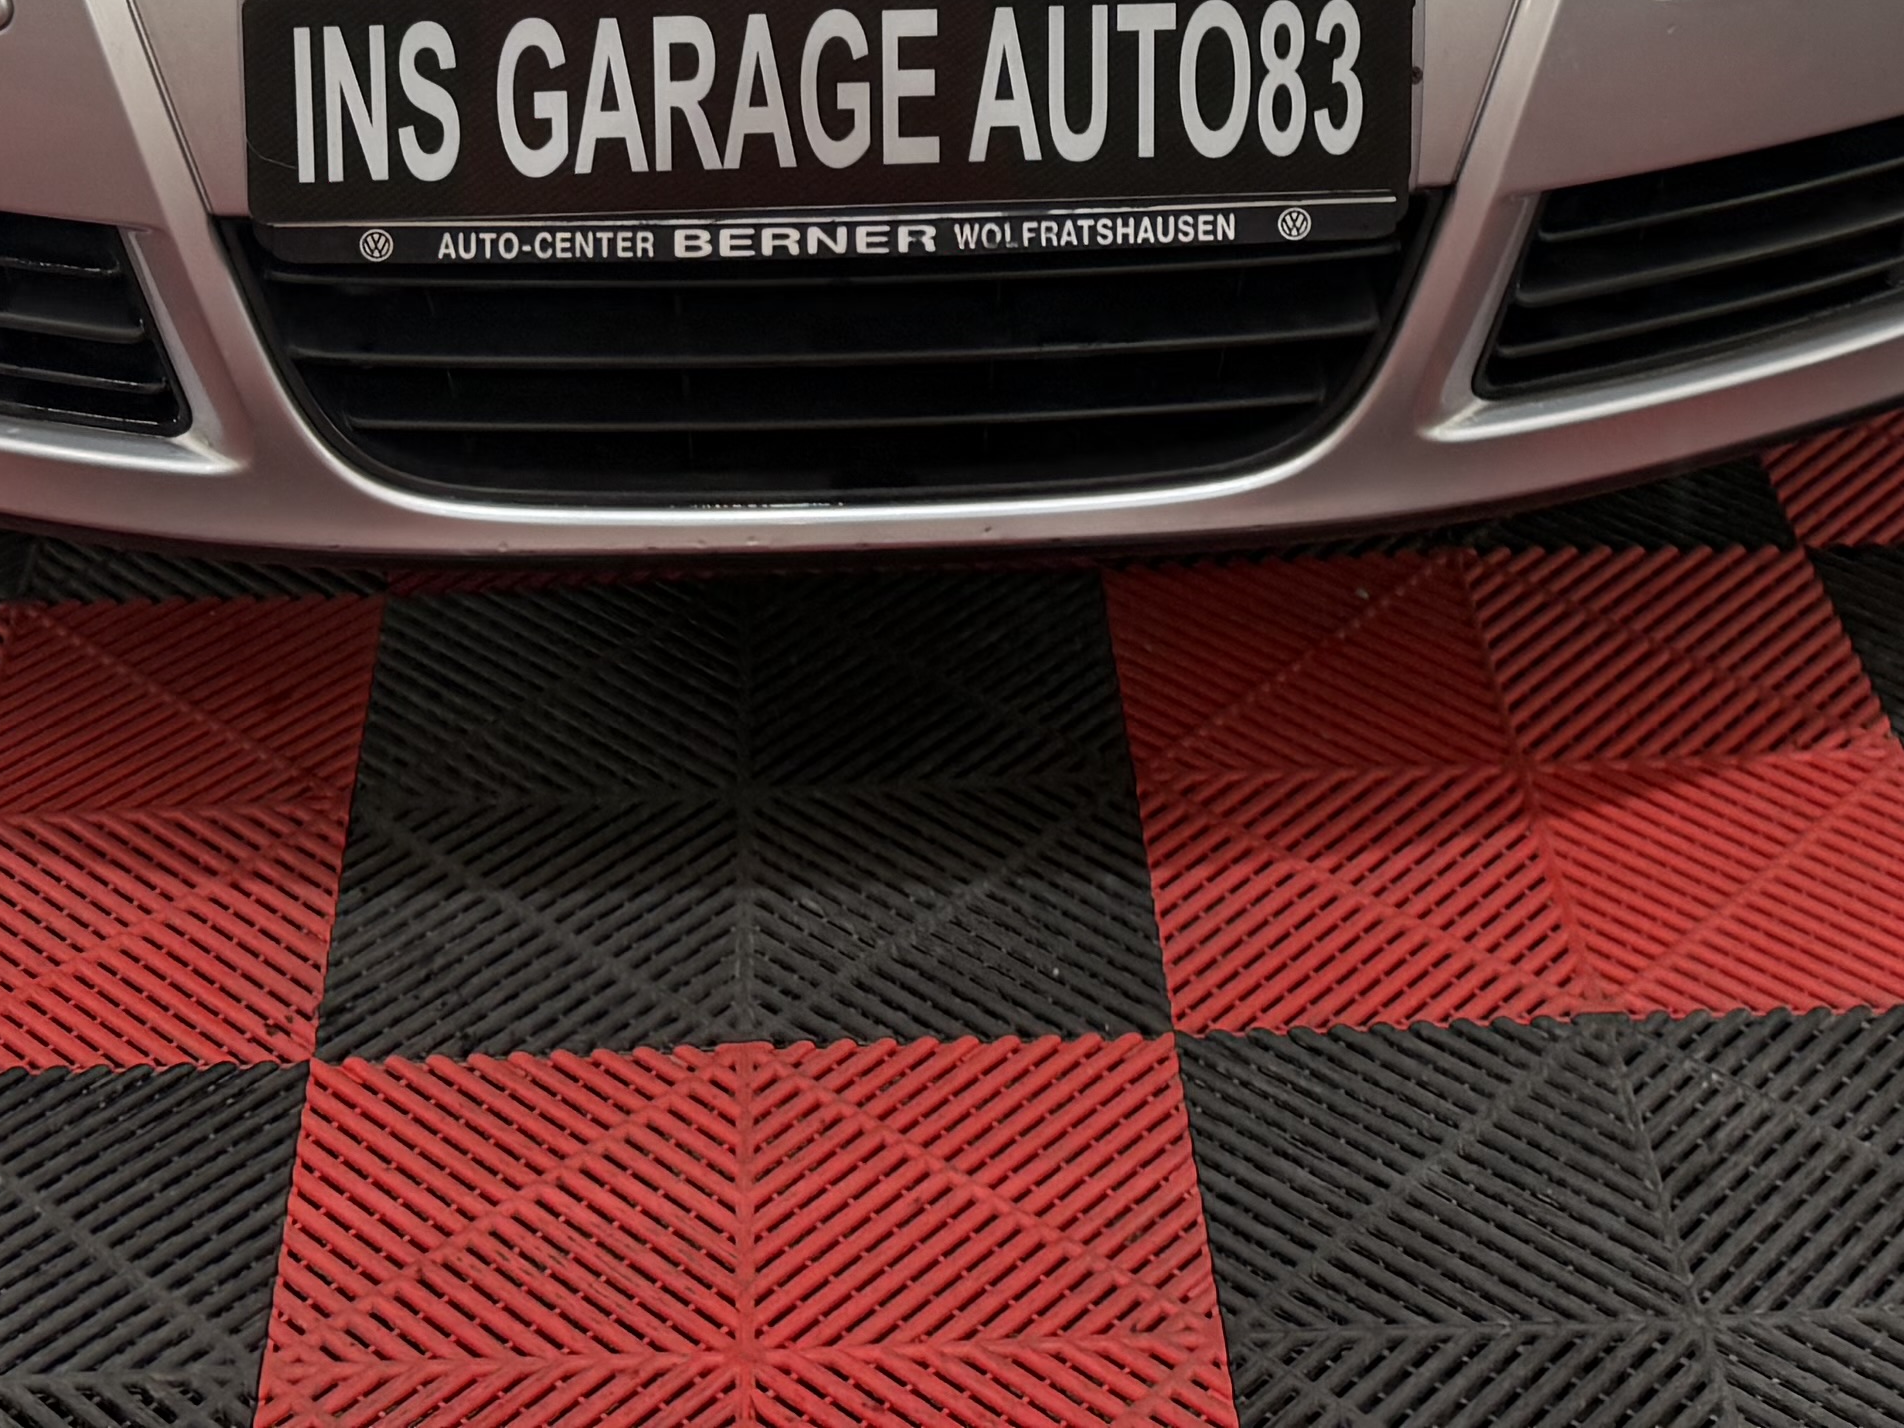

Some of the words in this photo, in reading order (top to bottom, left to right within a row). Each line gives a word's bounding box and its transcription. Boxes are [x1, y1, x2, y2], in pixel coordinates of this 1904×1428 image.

[294, 20, 461, 184] INS
[497, 8, 940, 178] GARAGE
[437, 231, 654, 260] AUTO-CENTER
[674, 225, 937, 258] BERNER
[954, 213, 1236, 250] WOLFRATSHAUSEN
